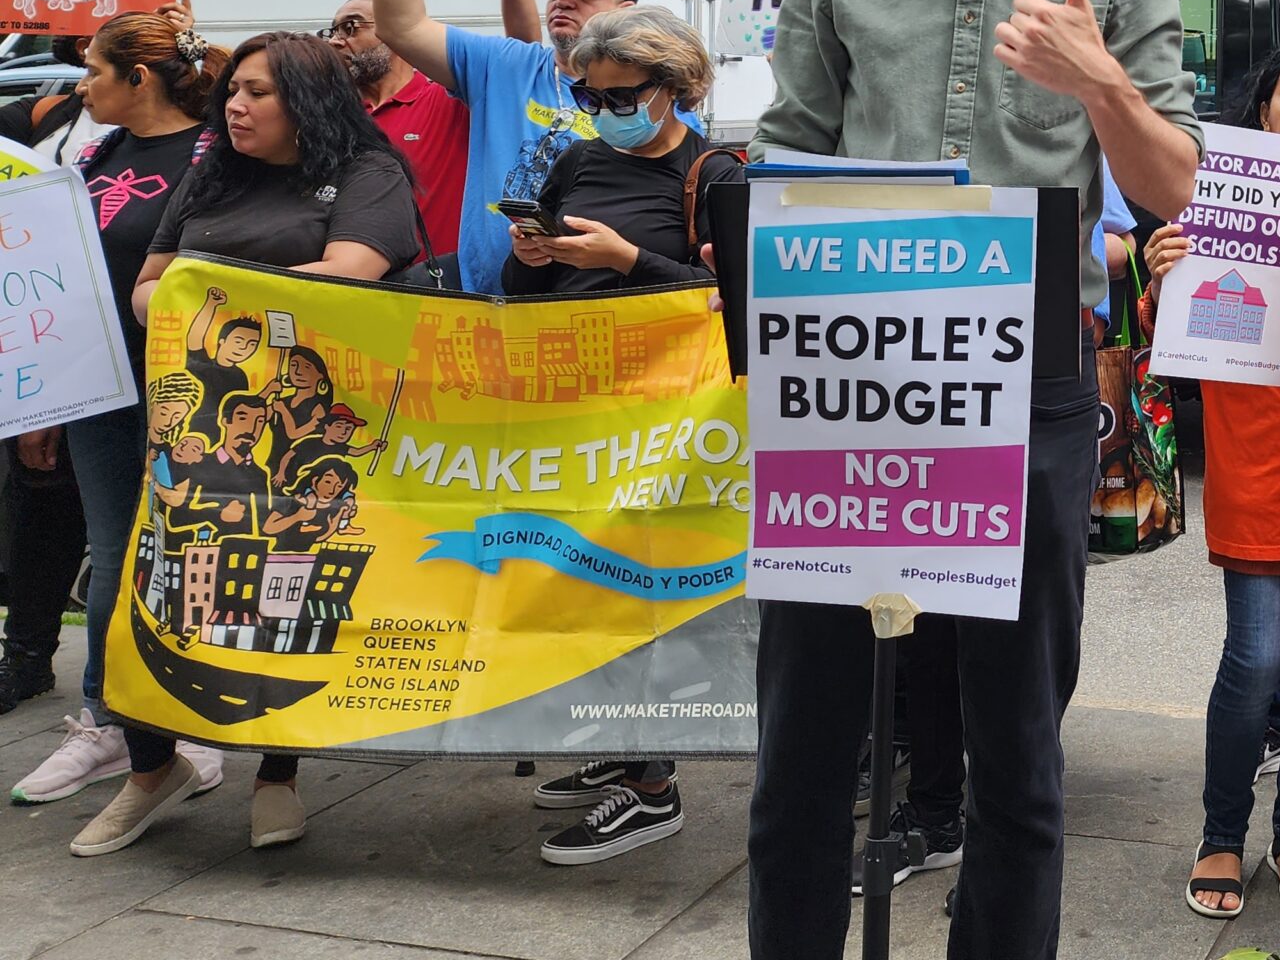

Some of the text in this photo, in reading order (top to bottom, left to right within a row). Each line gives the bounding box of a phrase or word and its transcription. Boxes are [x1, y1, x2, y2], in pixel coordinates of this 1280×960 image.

[1232, 185, 1263, 205] DID
[1178, 206, 1256, 233] DEFUND
[774, 236, 1012, 274] WE NEED A
[759, 313, 1025, 363] PEOPLE'S
[1157, 351, 1208, 363] #CareNotCuts
[780, 376, 1003, 427] BUDGET
[392, 435, 562, 492] MAKE
[845, 452, 935, 489] NOT
[607, 473, 687, 513] NEW
[1106, 476, 1126, 488] HOME
[766, 491, 1010, 541] MORE CUTS
[482, 530, 735, 590] DIGNIDAD, COMUNIDAD Y PODER
[752, 558, 1017, 588] #CareNotCuts #PeoplesBudget
[371, 618, 467, 633] BROOKLYN
[364, 636, 437, 651] QUEENS
[355, 656, 486, 673] STATEN ISLAND
[346, 676, 460, 692] LONG ISLAND
[327, 695, 452, 712] WESTCHESTER
[570, 702, 757, 719] WWW.MAKETHEROADN
